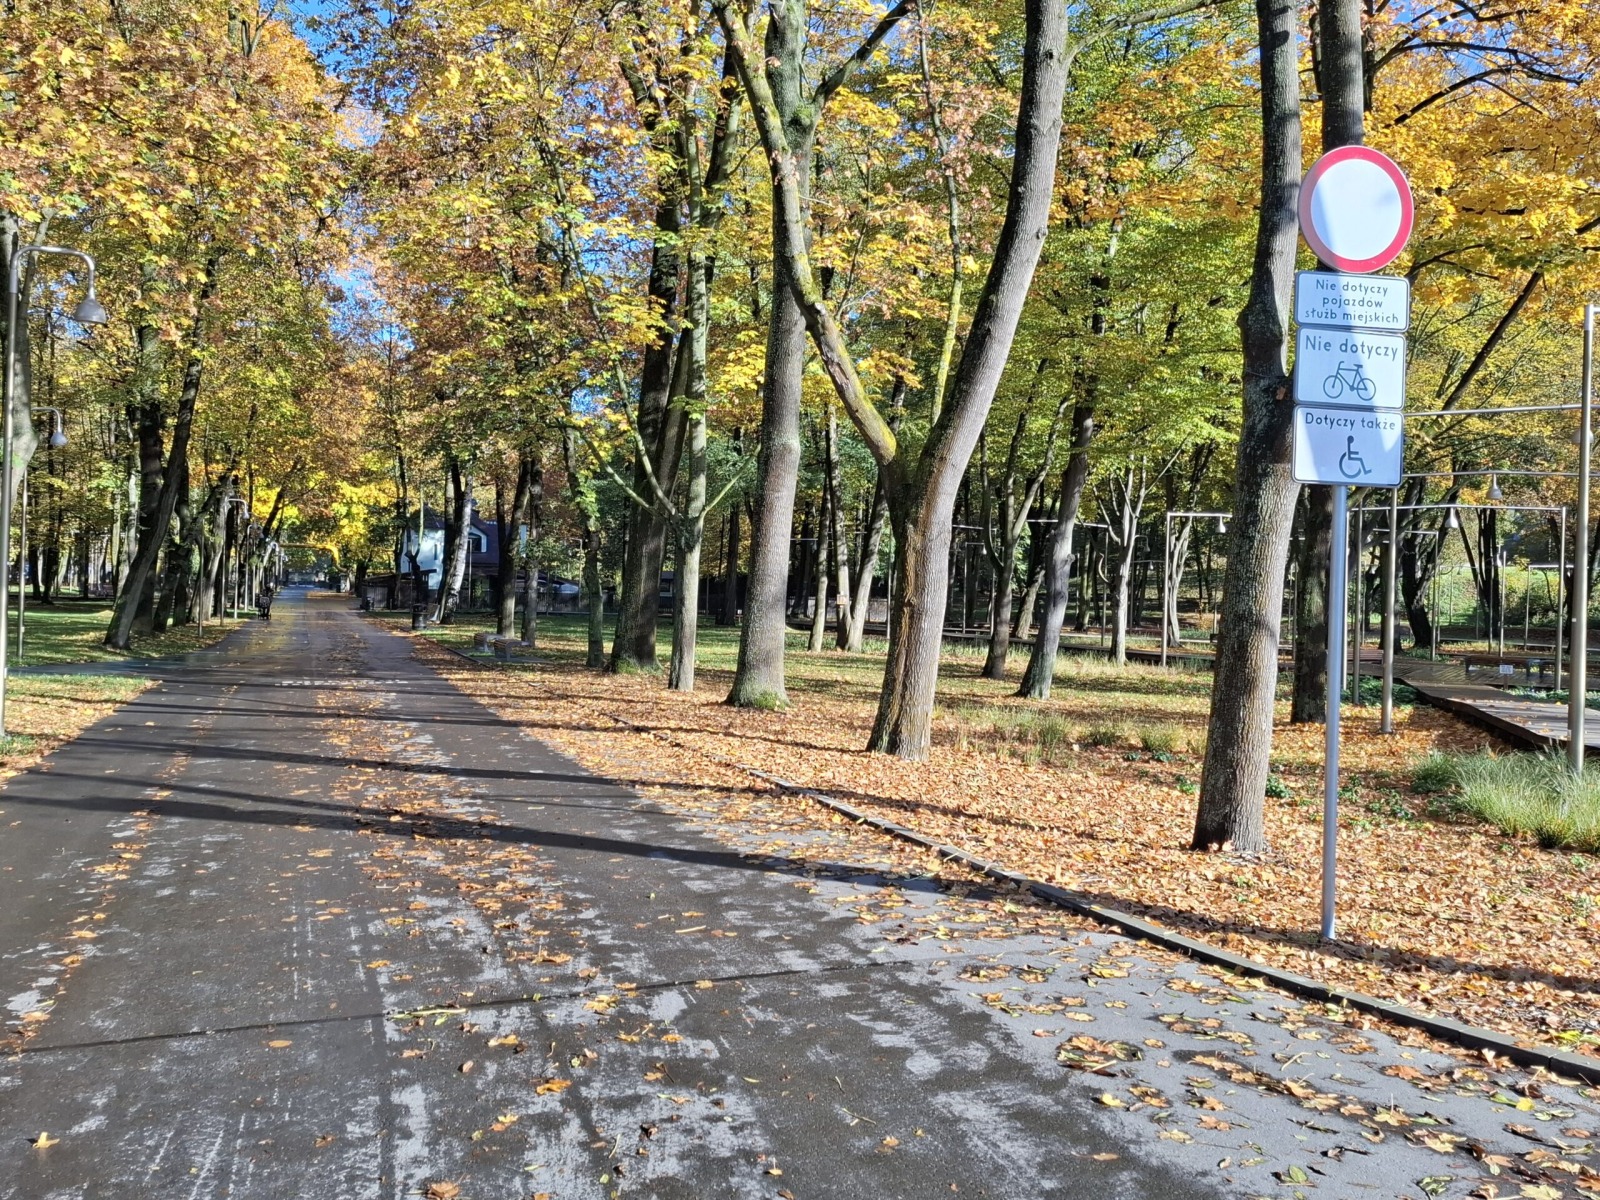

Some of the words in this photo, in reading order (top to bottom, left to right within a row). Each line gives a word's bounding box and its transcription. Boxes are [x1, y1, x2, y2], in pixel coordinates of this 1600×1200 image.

[1316, 279, 1336, 290] Nie
[1342, 282, 1388, 296] dotyczy
[1322, 295, 1383, 308] pojazdów
[1305, 308, 1337, 320] służb
[1342, 311, 1399, 324] miejskich
[1305, 335, 1332, 351] Nie
[1339, 338, 1398, 362] dotyczy
[1305, 412, 1355, 431] Dotyczy
[1361, 417, 1396, 430] także
